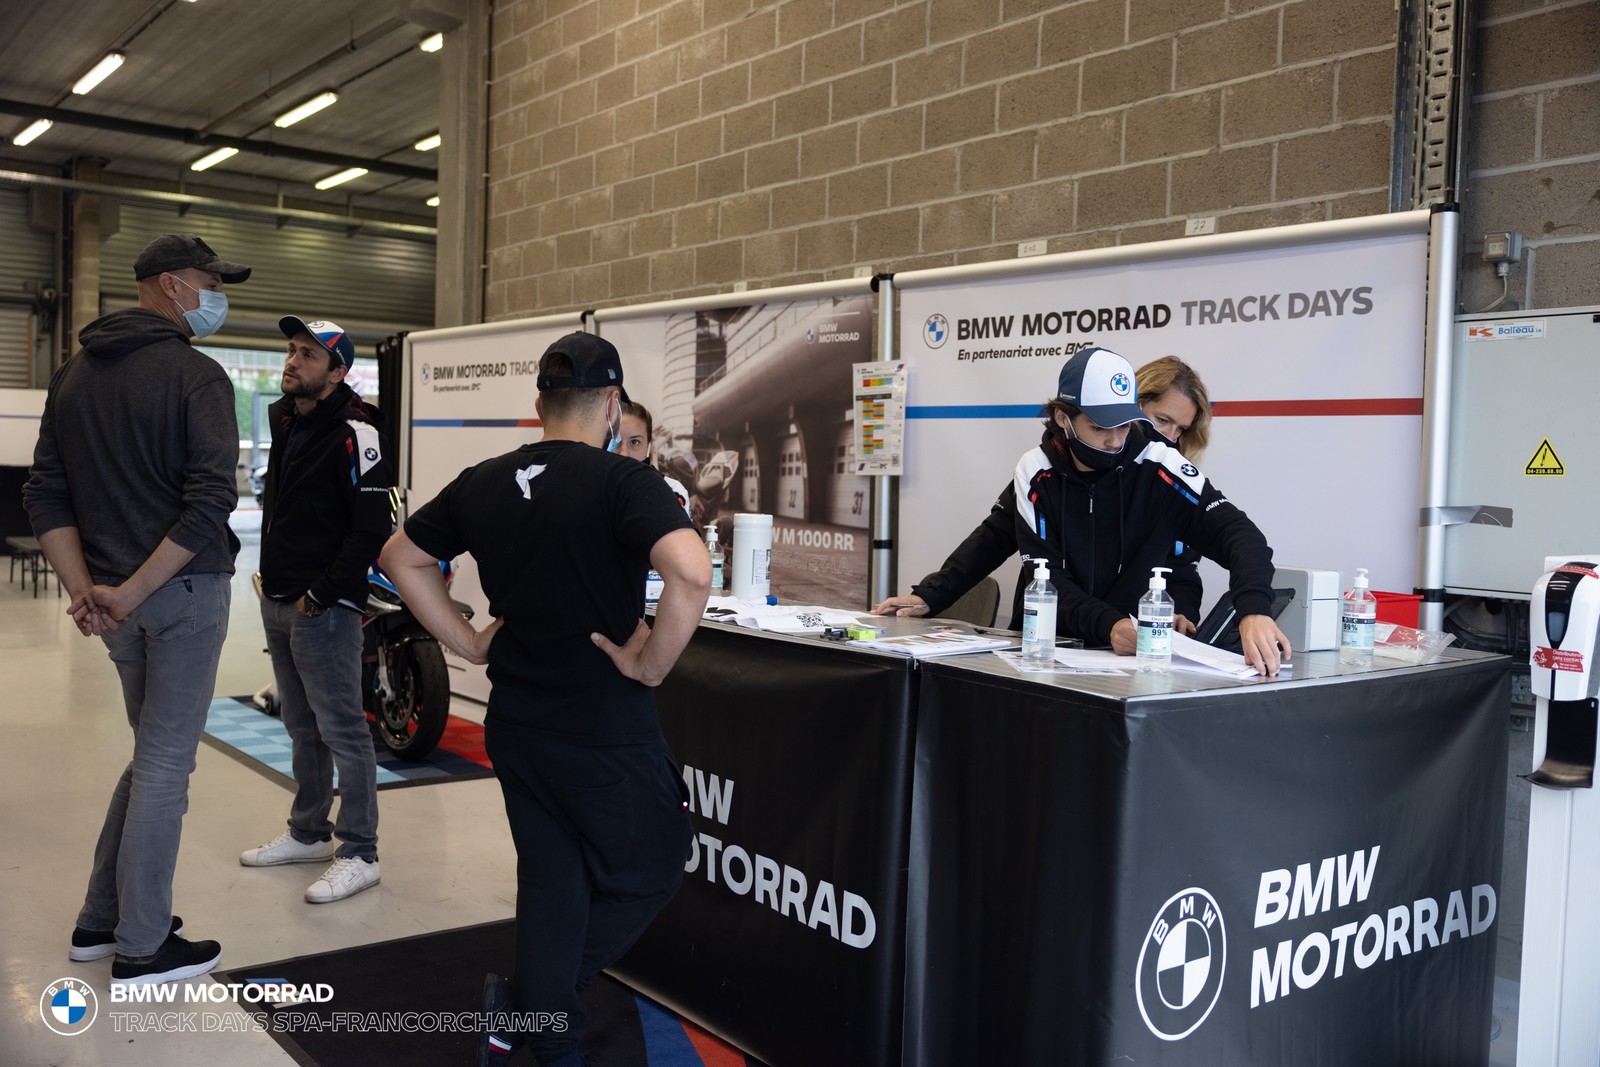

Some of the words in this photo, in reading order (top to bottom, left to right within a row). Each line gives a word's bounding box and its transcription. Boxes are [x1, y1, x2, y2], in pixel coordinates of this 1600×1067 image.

[957, 315, 1015, 341] BMW
[1021, 303, 1171, 337] MOTORRAD
[1180, 294, 1282, 326] TRACK
[1287, 286, 1374, 320] DAYS
[818, 332, 860, 344] MOTORRAD
[819, 323, 838, 333] BMW
[957, 349, 970, 360] En
[971, 345, 1033, 362] partenariat
[1034, 345, 1062, 357] avec
[433, 366, 455, 380] BMW
[456, 362, 507, 379] MOTORRAD
[852, 491, 864, 515] 31
[783, 528, 795, 545] M
[797, 530, 831, 549] 1000
[834, 532, 854, 551] RR
[1151, 628, 1168, 637] 99%
[684, 832, 877, 949] TORRAD
[1254, 845, 1381, 929] BMW
[1250, 884, 1497, 1010] MOTORRAD
